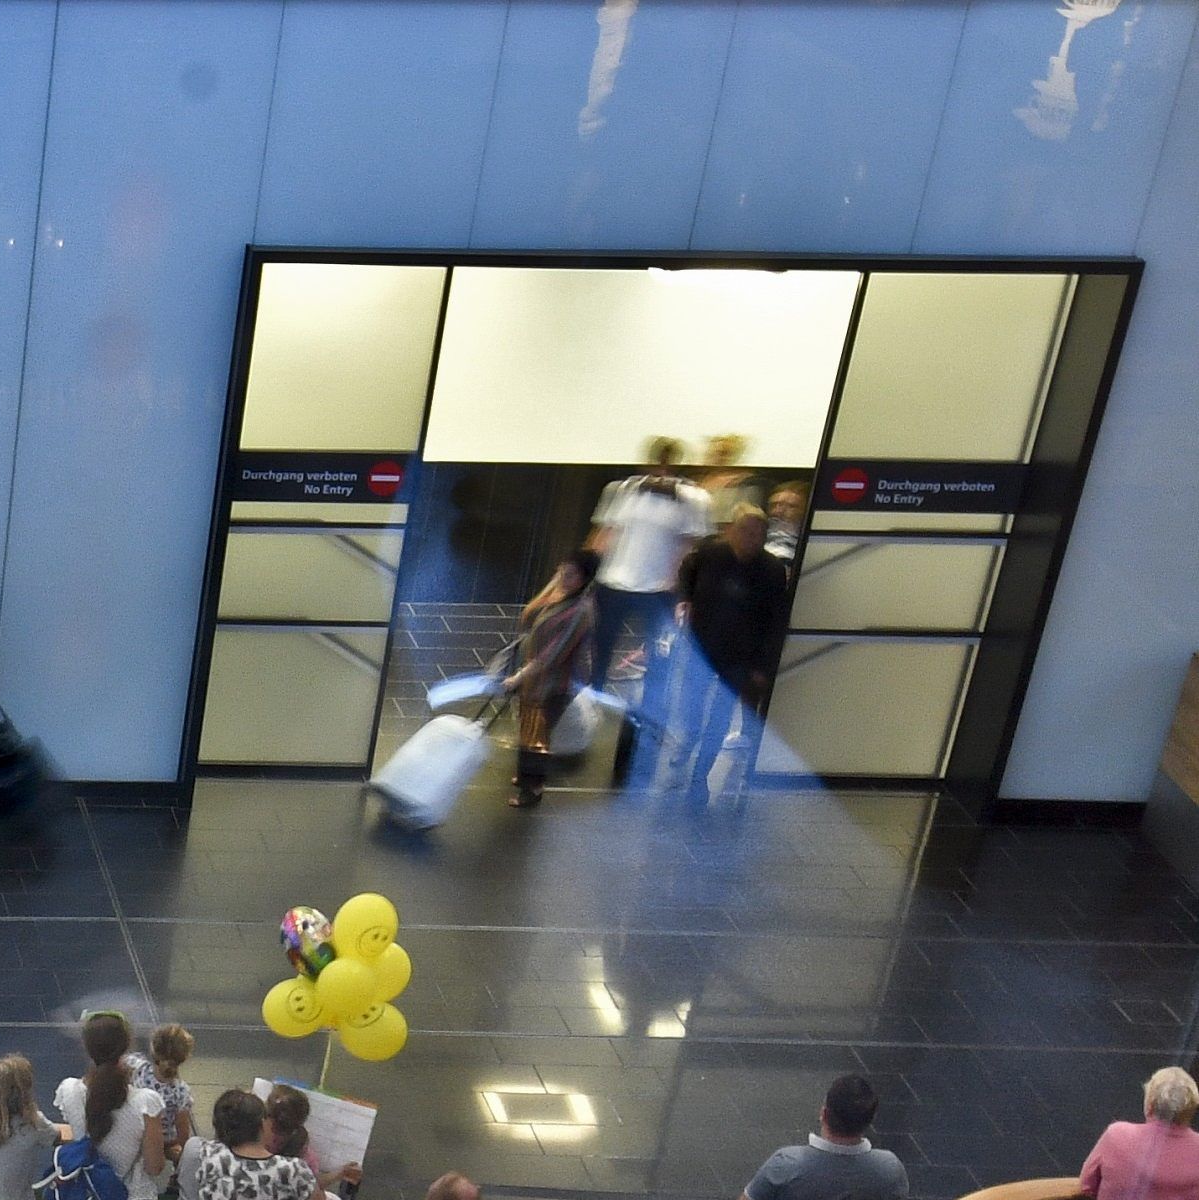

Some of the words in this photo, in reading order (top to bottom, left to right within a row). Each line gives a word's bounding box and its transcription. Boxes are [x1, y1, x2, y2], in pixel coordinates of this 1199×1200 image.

[241, 469, 305, 483] Durchgang
[306, 471, 358, 482] verboten
[303, 484, 321, 495] No
[322, 484, 354, 497] Entry
[877, 479, 941, 493] Durchgang
[943, 481, 996, 492] verboten
[874, 493, 891, 504] No
[893, 494, 925, 507] Entry
